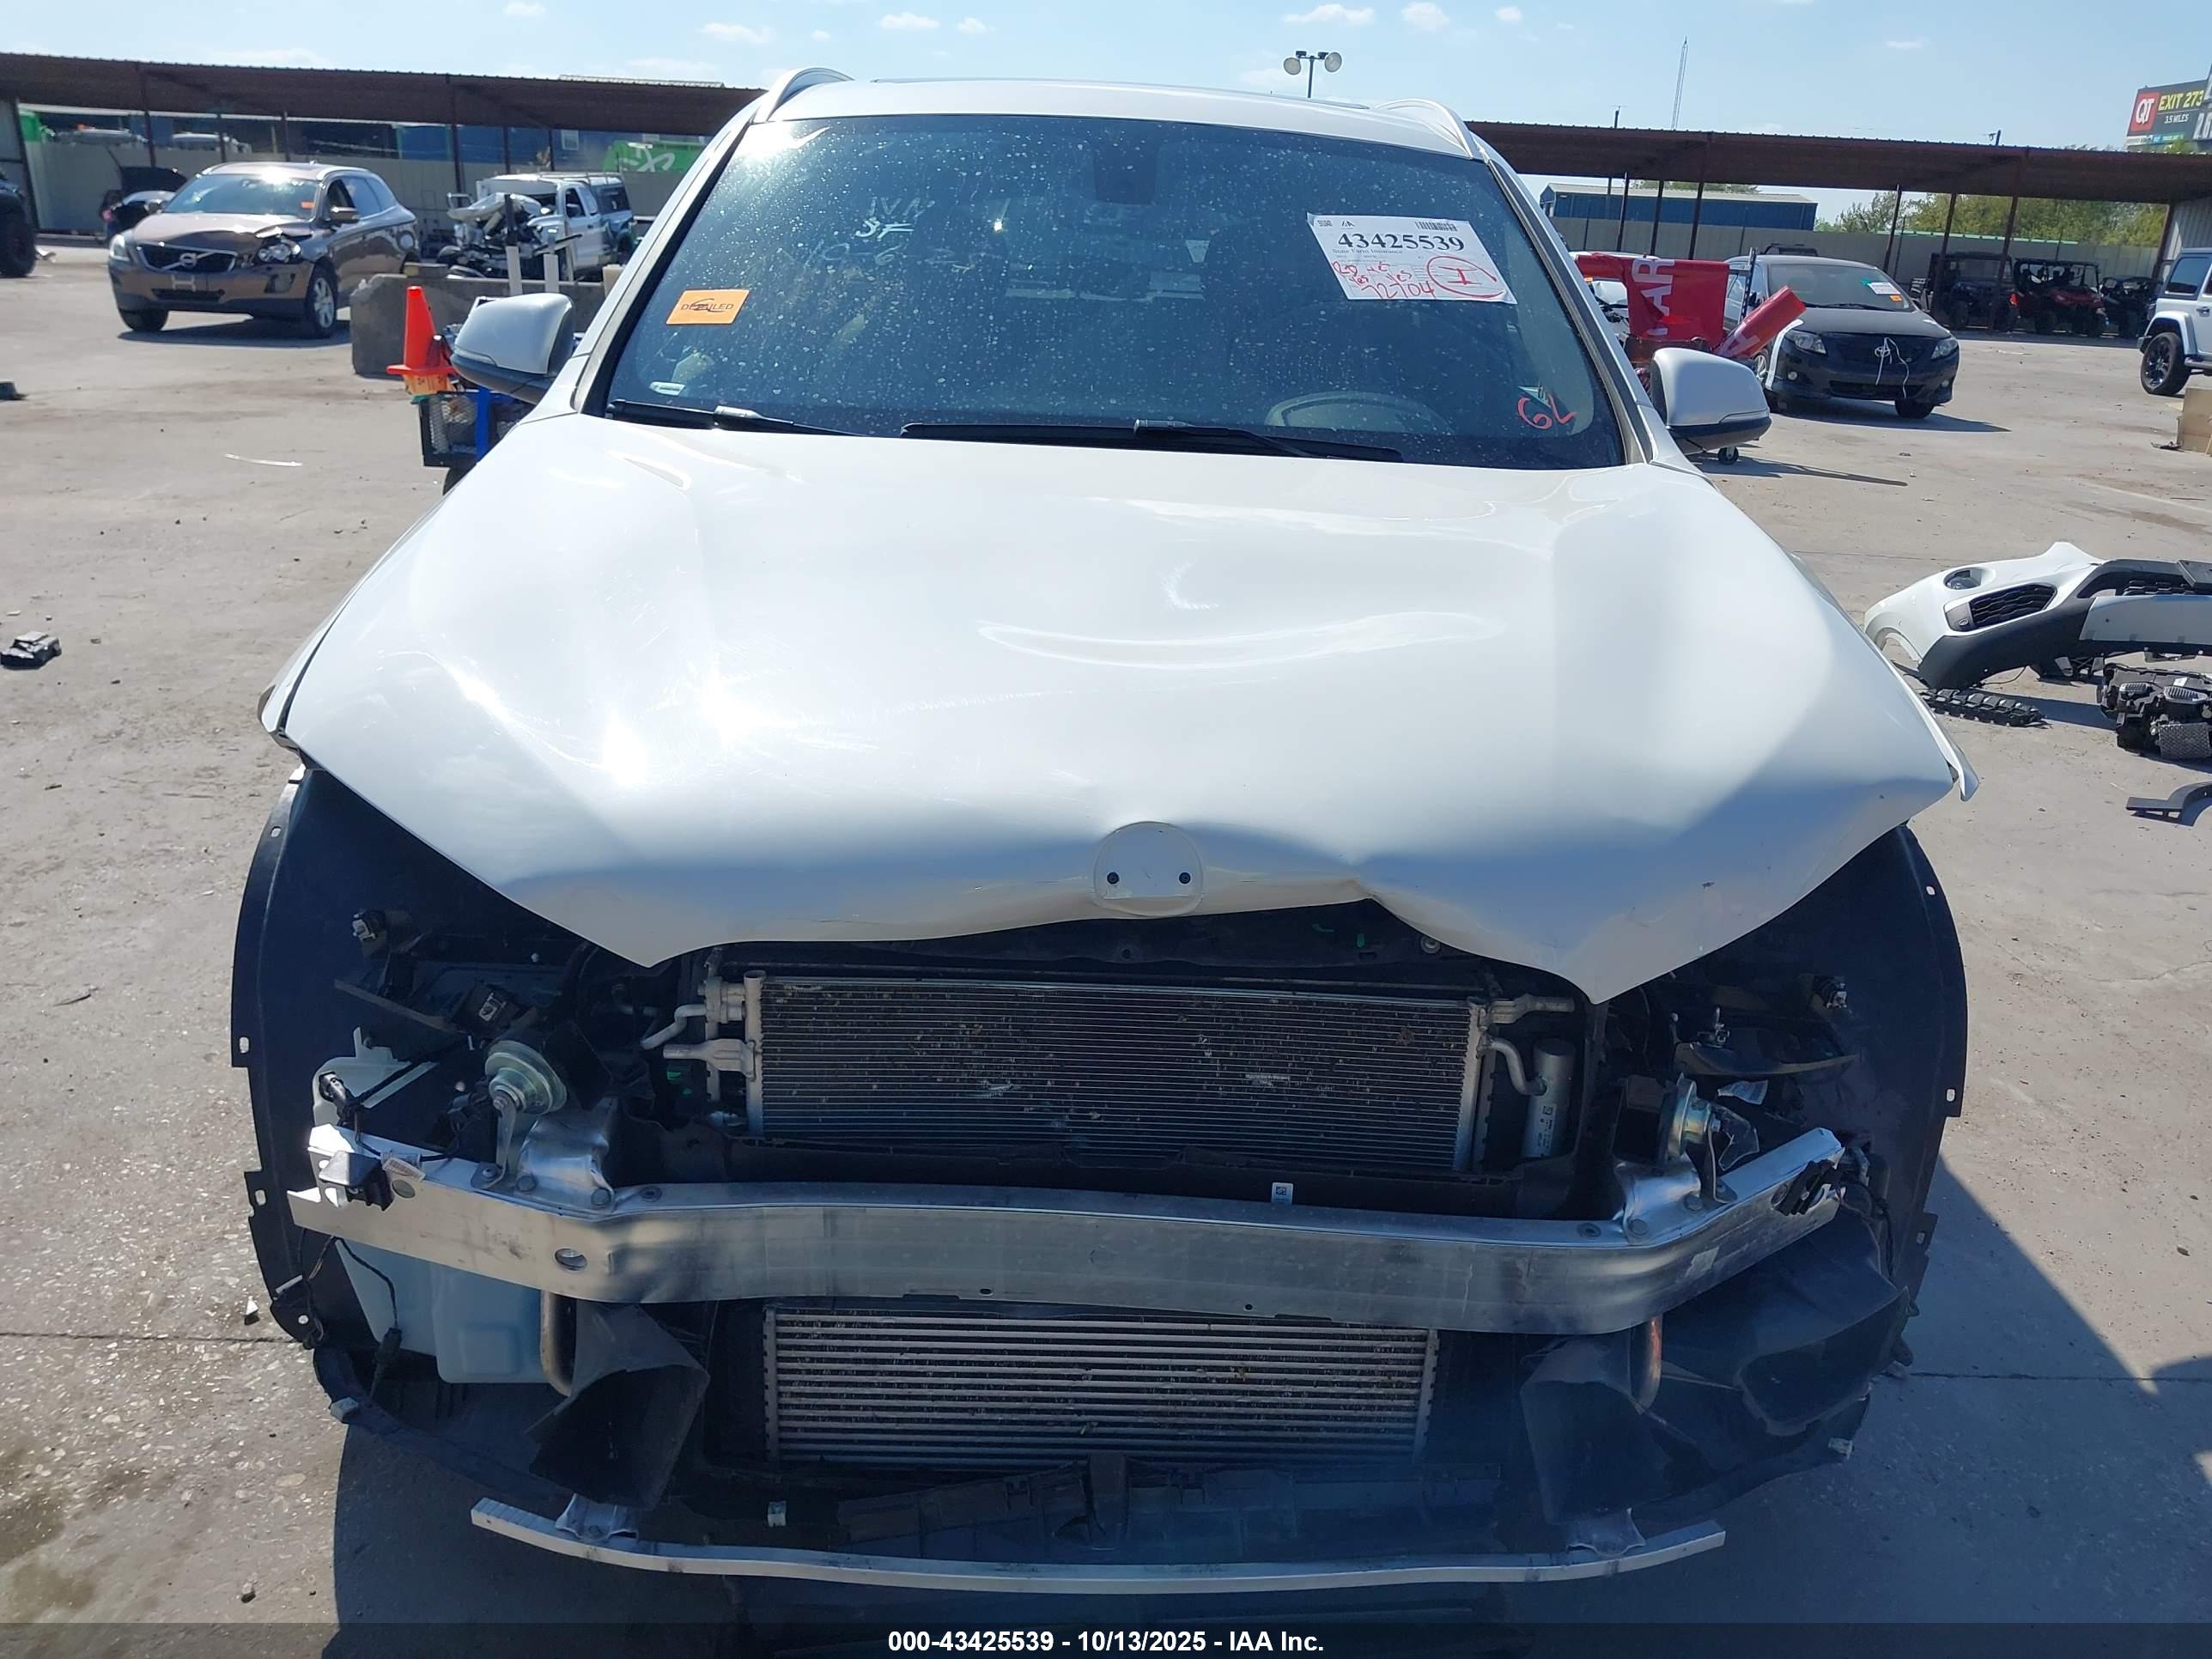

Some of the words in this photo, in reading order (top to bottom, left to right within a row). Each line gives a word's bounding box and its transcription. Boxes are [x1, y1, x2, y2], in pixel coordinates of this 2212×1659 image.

[2158, 93, 2185, 111] EXIT
[2182, 90, 2205, 108] 273
[2136, 98, 2155, 125] QT
[2172, 113, 2190, 124] MILES
[1338, 233, 1465, 252] 43425539
